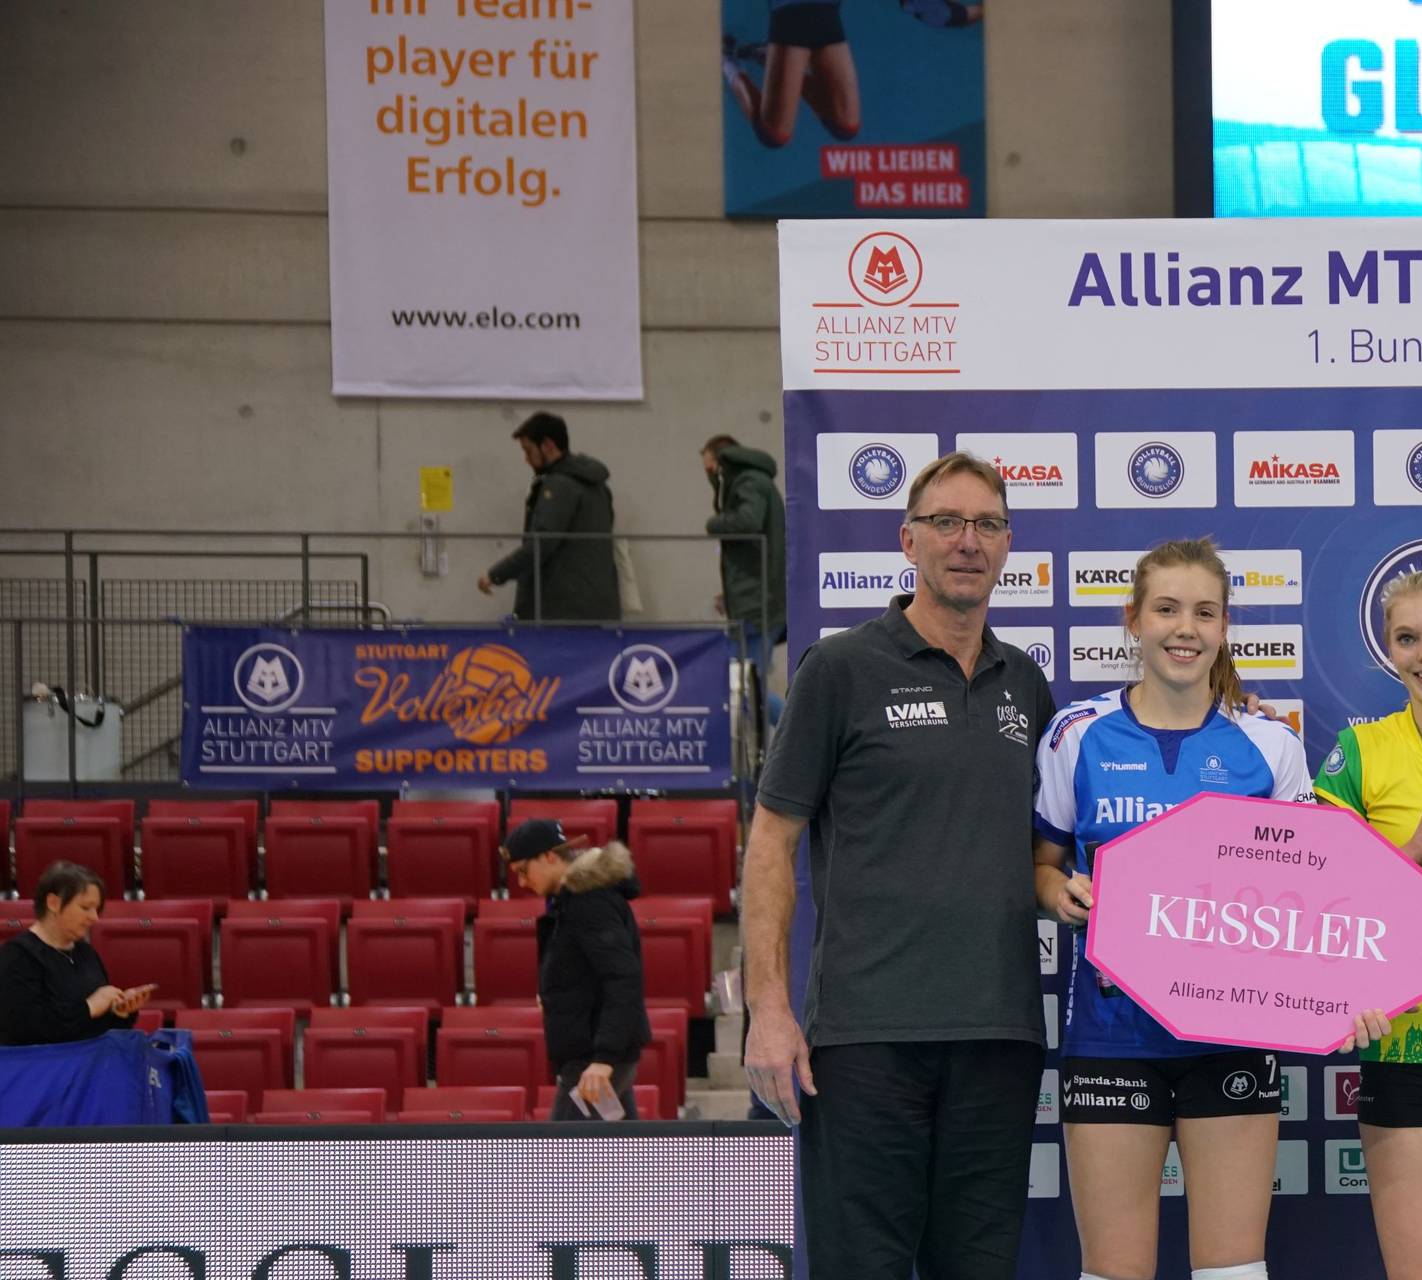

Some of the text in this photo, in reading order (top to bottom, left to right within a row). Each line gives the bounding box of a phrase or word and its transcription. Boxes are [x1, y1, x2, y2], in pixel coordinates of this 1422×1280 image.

[366, 34, 599, 87] player für
[376, 94, 588, 145] digitalen
[827, 150, 955, 172] WIR LIEBEN
[407, 155, 560, 207] Erfolg.
[860, 182, 963, 203] DAS HIER
[1068, 251, 1304, 307] Allianz
[392, 307, 581, 330] www.elo.com
[816, 316, 957, 334] ALLIANZ MTV
[815, 341, 958, 362] STUTTGART
[1307, 333, 1339, 364] 1.
[856, 449, 898, 468] VOLLEYBALL
[1134, 448, 1176, 468] VOLLEYBALL
[857, 476, 899, 494] BUNDESLIGA
[1136, 475, 1177, 493] BUNDESLIGA
[822, 571, 893, 590] Allianz
[355, 645, 448, 660] STUTTGART
[1232, 642, 1295, 656] RCHER
[890, 686, 933, 695] STANNO
[354, 666, 562, 737] Volleyball
[885, 703, 928, 721] LVM
[202, 718, 334, 737] ALLIANZ MTV
[579, 718, 707, 737] ALLIANZ MTV
[889, 718, 949, 729] VERSICHERUNG
[201, 740, 334, 762] STUTTGART
[355, 748, 548, 773] SUPPORTERS
[578, 740, 707, 762] STUTTGART
[1111, 762, 1147, 771] hummel
[1254, 826, 1295, 843] MVP
[1217, 843, 1327, 870] presented by
[1145, 893, 1387, 962] KESSLER
[1168, 981, 1350, 1016] Allianz MTV Stuttgart
[1265, 1054, 1277, 1084] 7
[1073, 1074, 1148, 1088] Sparda-Bank
[1073, 1092, 1126, 1107] Allianz
